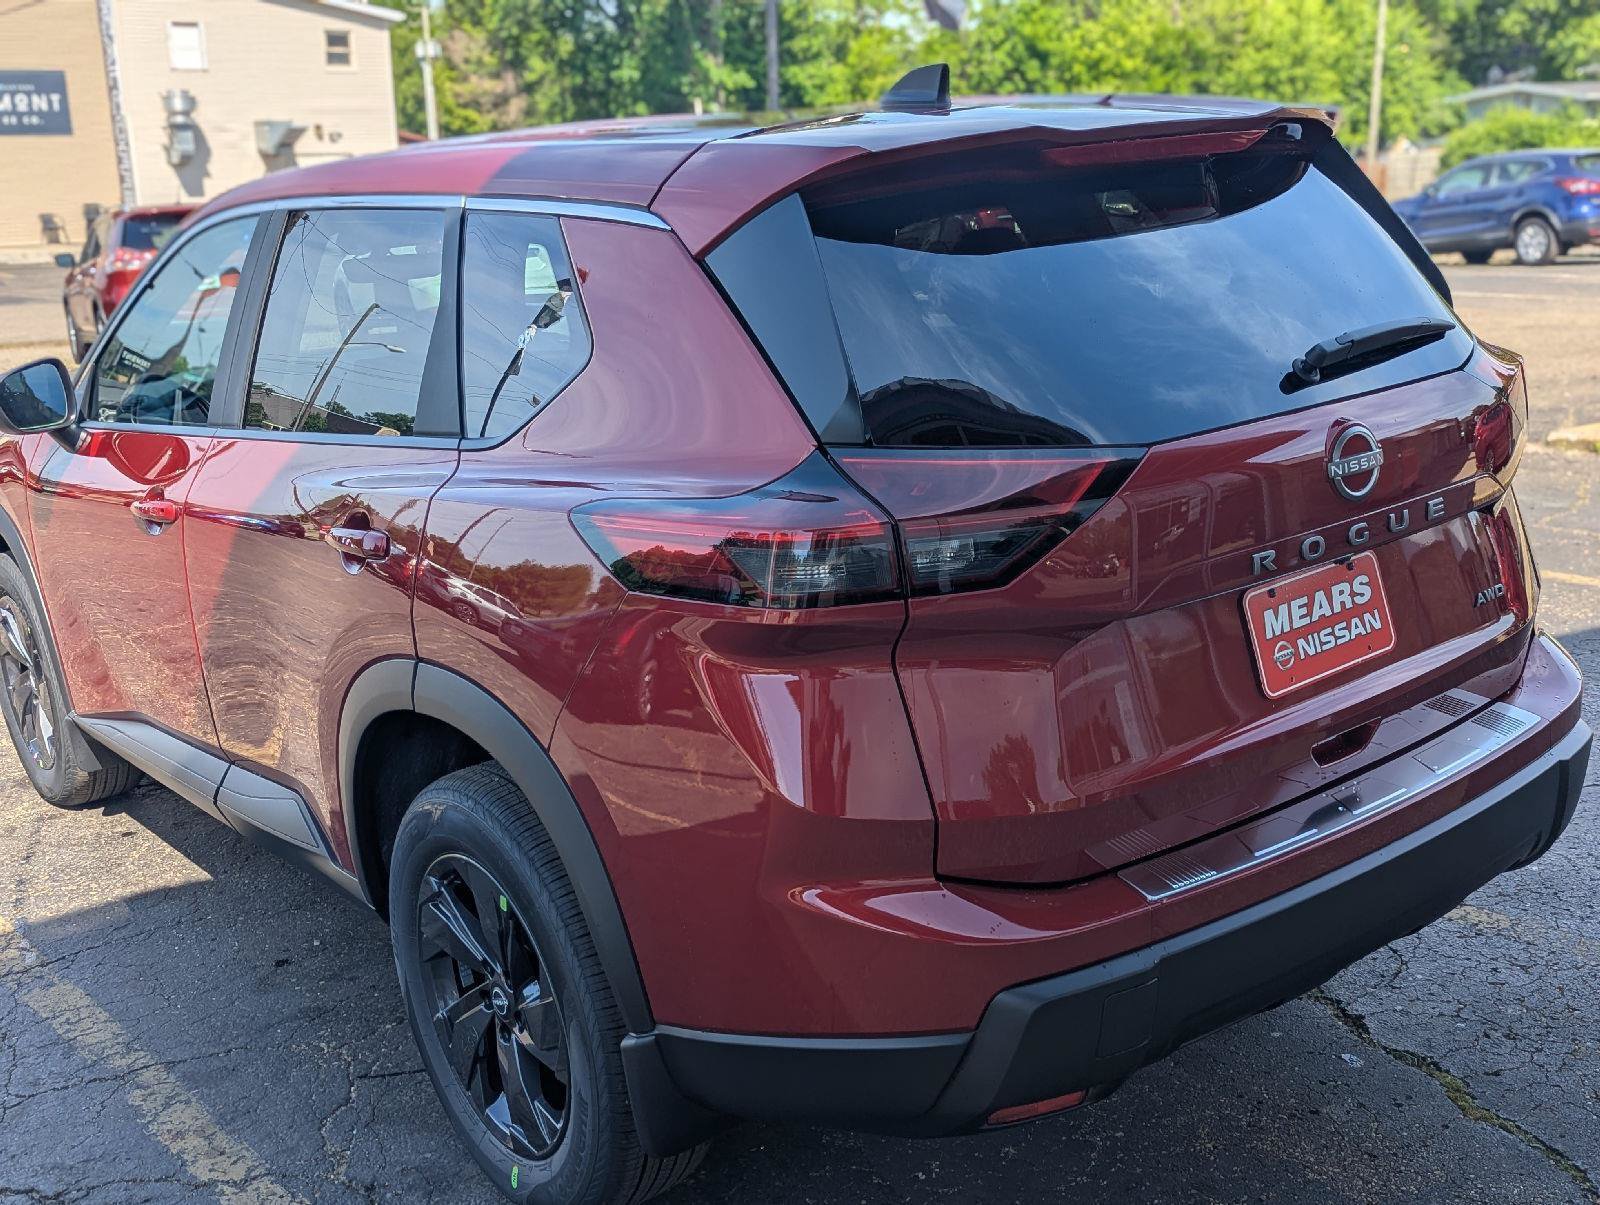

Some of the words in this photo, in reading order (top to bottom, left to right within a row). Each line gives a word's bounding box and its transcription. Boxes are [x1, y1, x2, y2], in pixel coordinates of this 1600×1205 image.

[1331, 453, 1384, 477] NISSAN
[1252, 497, 1445, 576] ROGUE
[1264, 575, 1372, 640] MEARS
[1476, 583, 1504, 607] AWD
[1296, 608, 1382, 660] NISSAN
